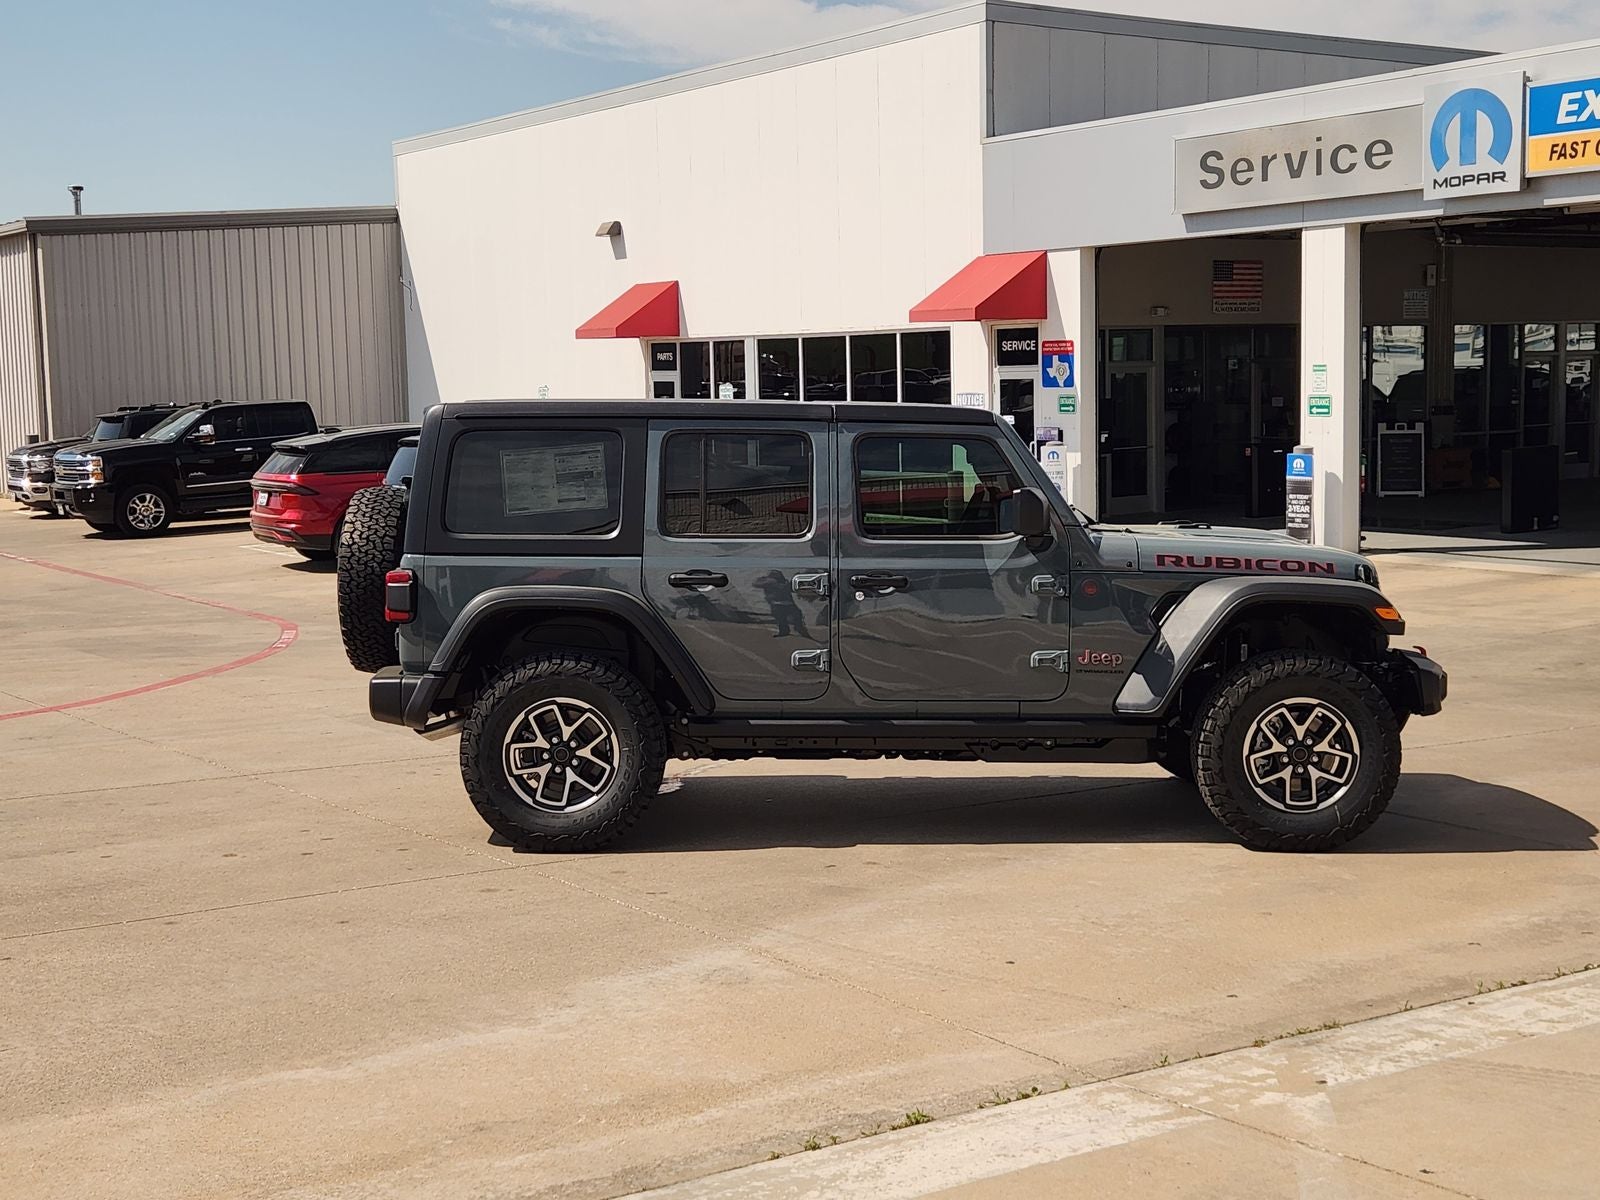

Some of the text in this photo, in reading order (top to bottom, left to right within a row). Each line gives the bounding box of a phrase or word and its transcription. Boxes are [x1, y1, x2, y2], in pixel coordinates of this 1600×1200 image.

[1548, 140, 1591, 161] FAST
[1199, 136, 1394, 190] Service
[1433, 170, 1508, 190] MOPAR
[1001, 340, 1037, 351] SERVICE
[656, 352, 674, 361] PARTS
[956, 394, 985, 406] NOTICE
[1287, 504, 1311, 513] 2-YEAR
[1155, 553, 1336, 575] RUBICON
[1077, 649, 1123, 668] Jeep
